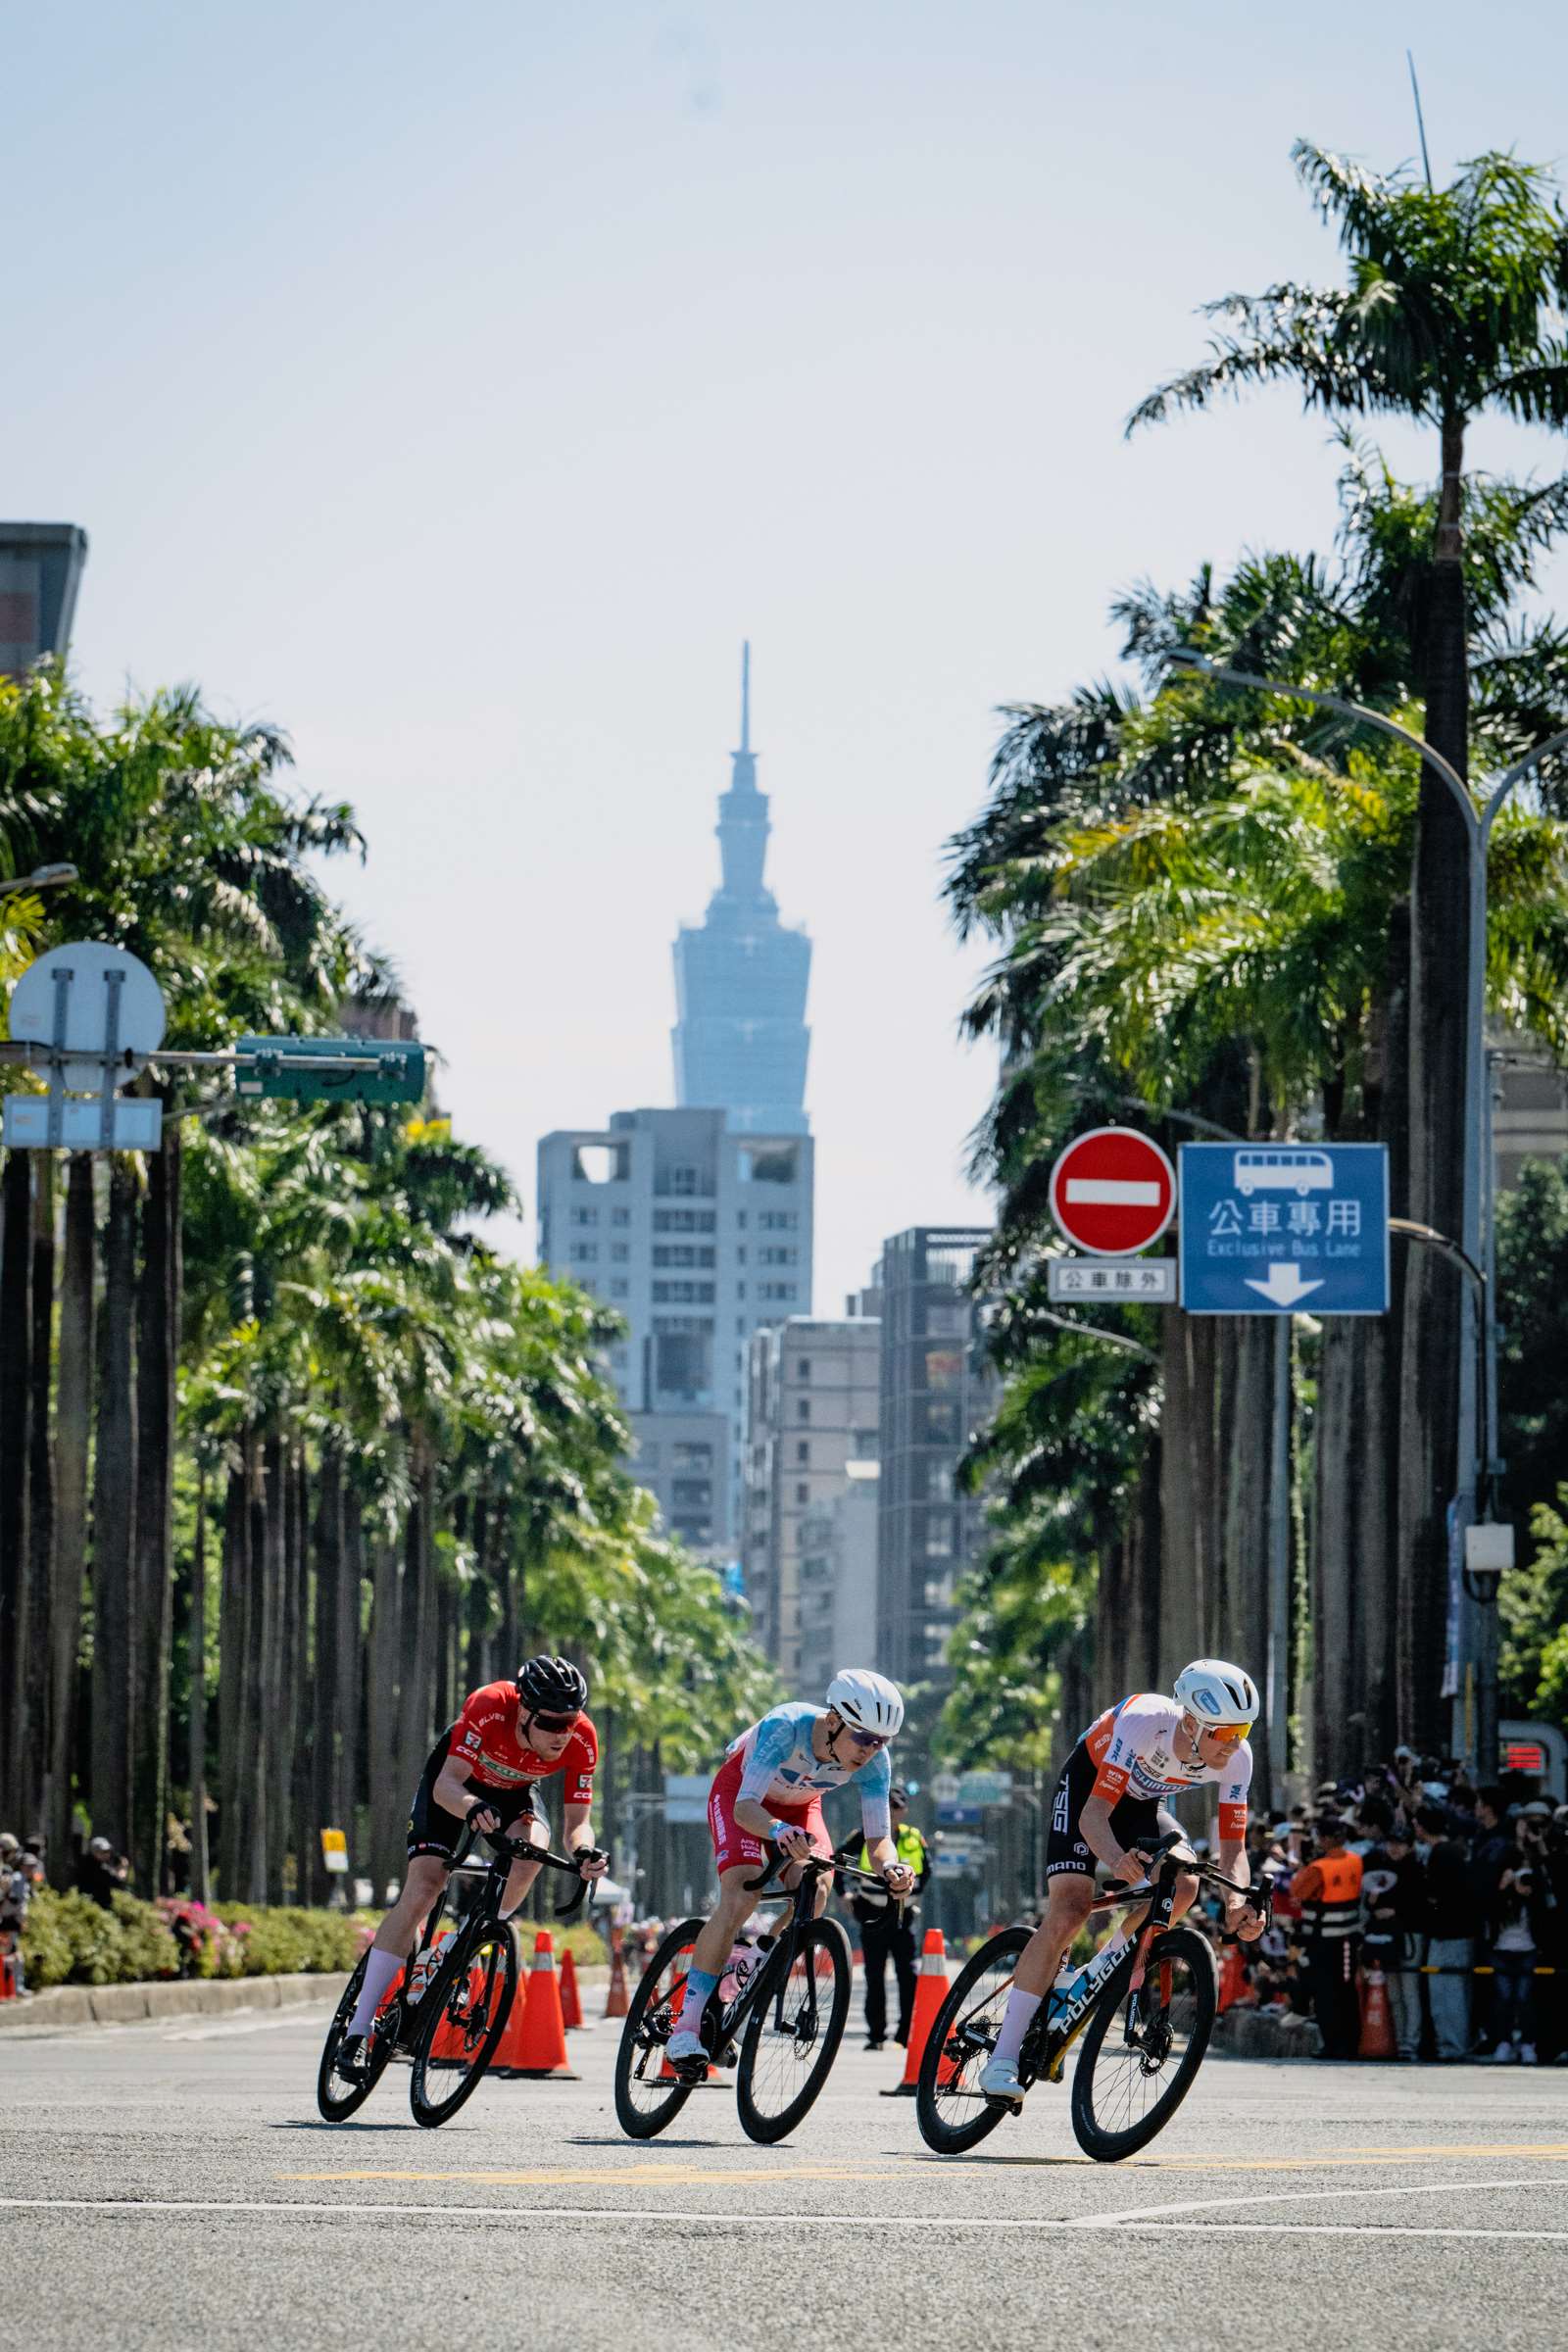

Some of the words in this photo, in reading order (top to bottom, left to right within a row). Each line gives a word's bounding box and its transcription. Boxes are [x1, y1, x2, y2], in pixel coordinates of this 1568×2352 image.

[1208, 1200, 1360, 1236] 公車專用
[1206, 1239, 1286, 1255] Exclusive
[1292, 1239, 1318, 1255] Bus
[1325, 1240, 1361, 1256] Lane
[1052, 1772, 1070, 1836] TSG
[1059, 1933, 1138, 2034] POLYGON
